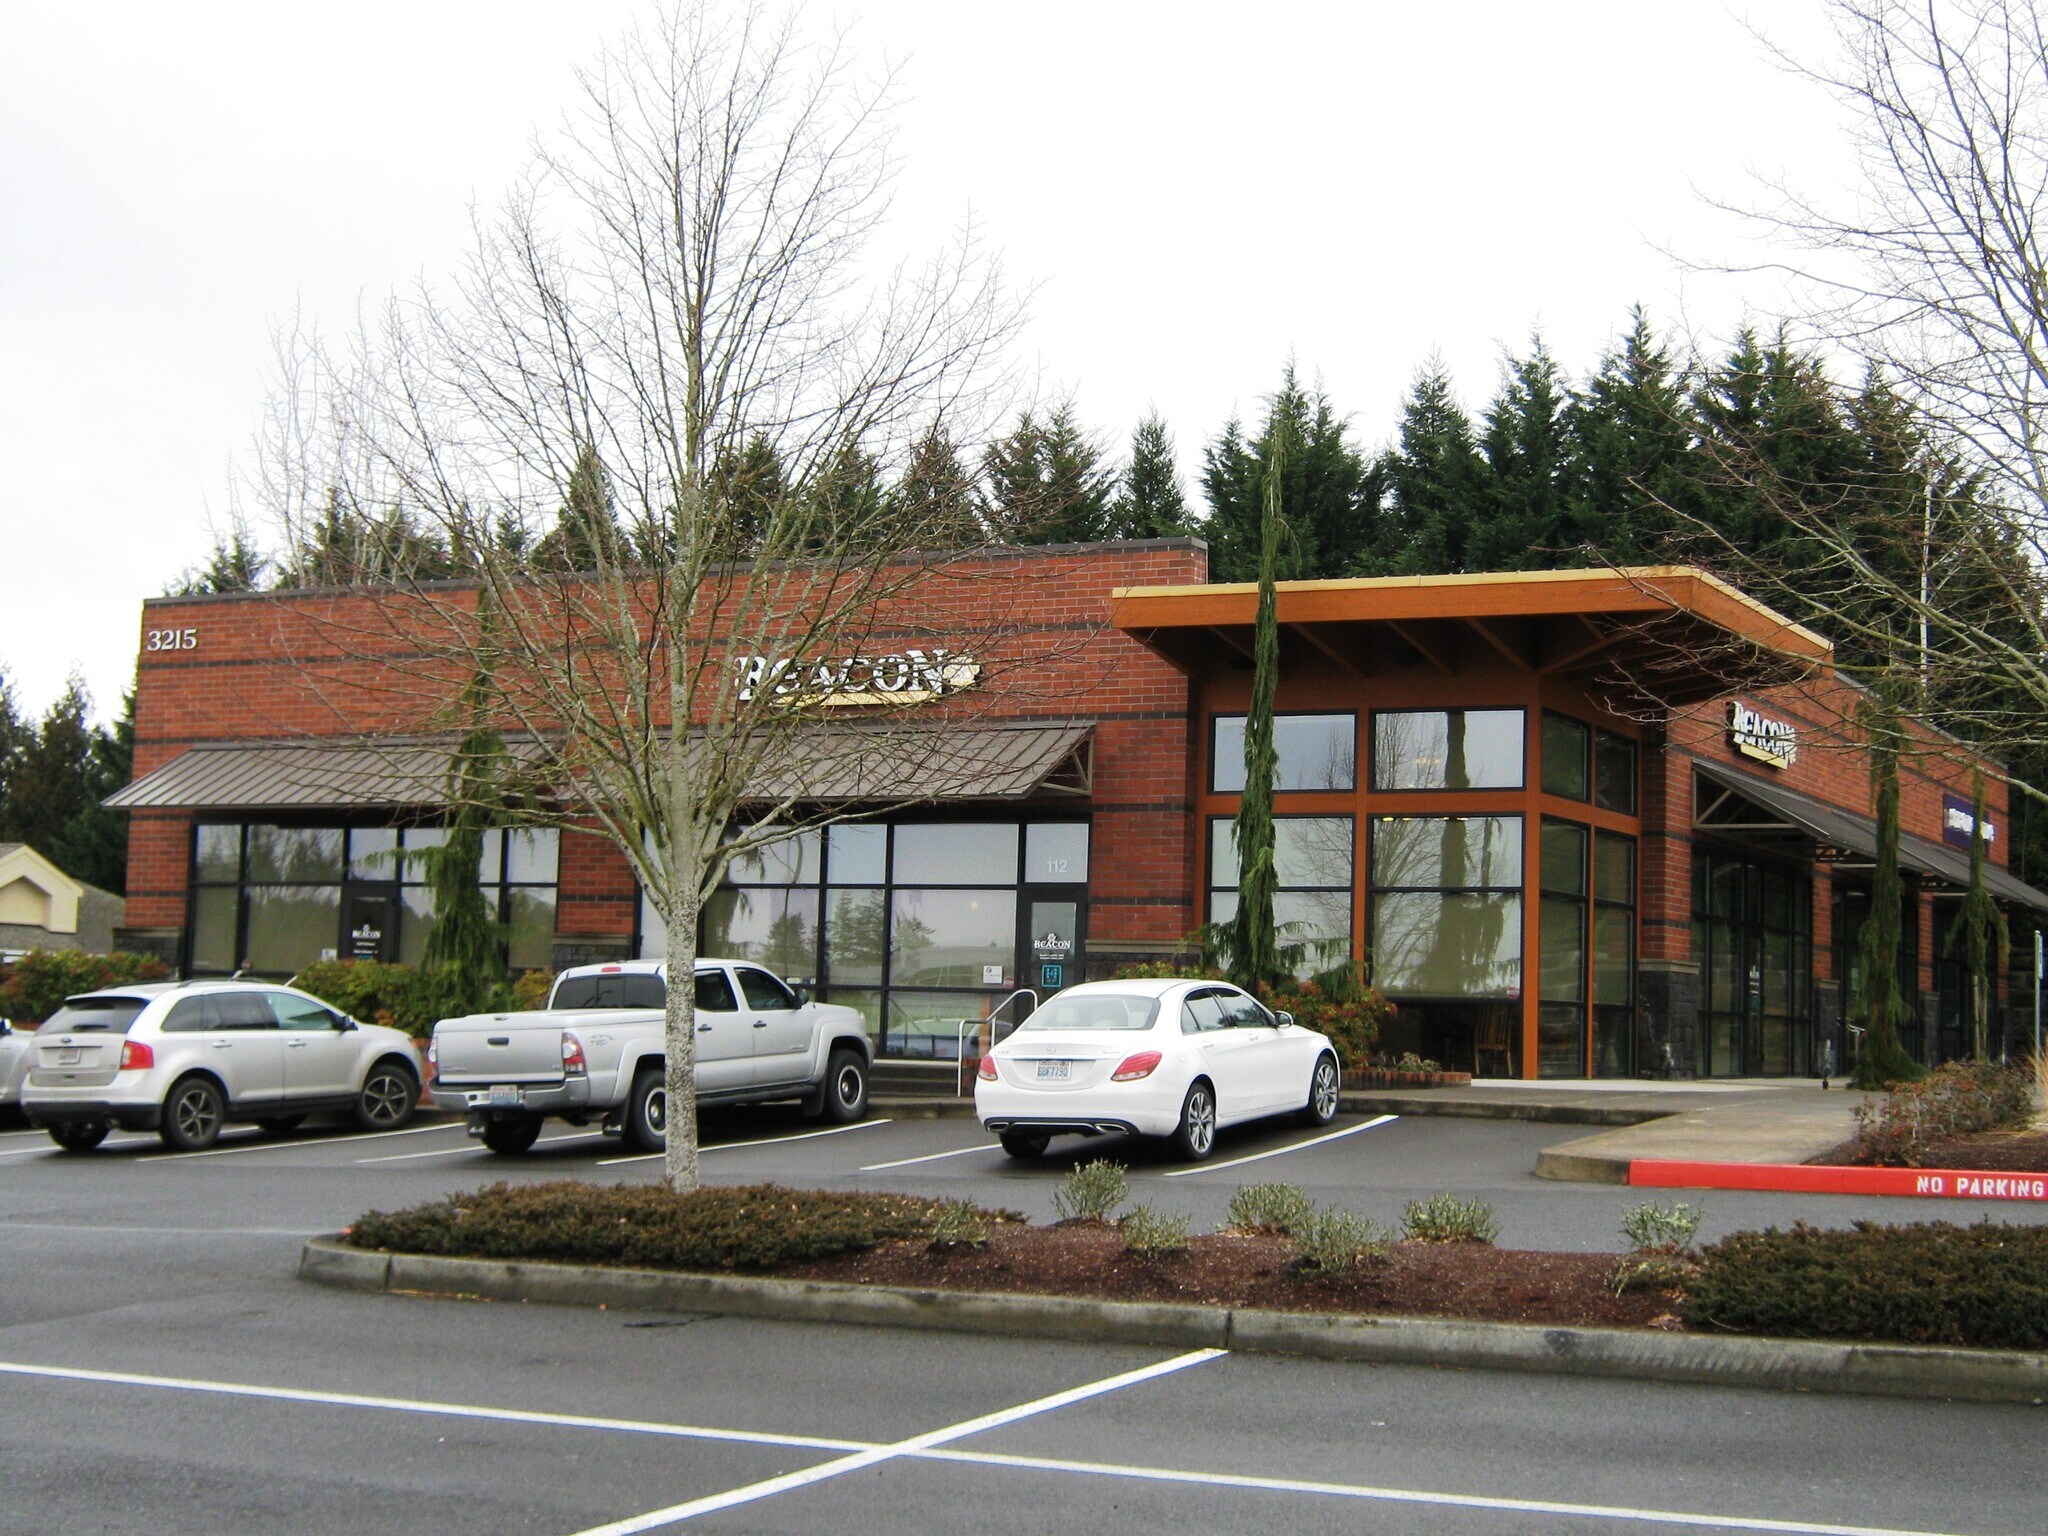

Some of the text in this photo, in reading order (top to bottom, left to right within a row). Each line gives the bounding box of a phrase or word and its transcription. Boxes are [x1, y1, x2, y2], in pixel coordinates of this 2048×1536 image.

[147, 628, 198, 651] 3215
[734, 649, 949, 700] BEACON
[1046, 860, 1067, 873] 112
[1033, 940, 1071, 950] BEACON
[1916, 1176, 2044, 1197] NO PARKING
